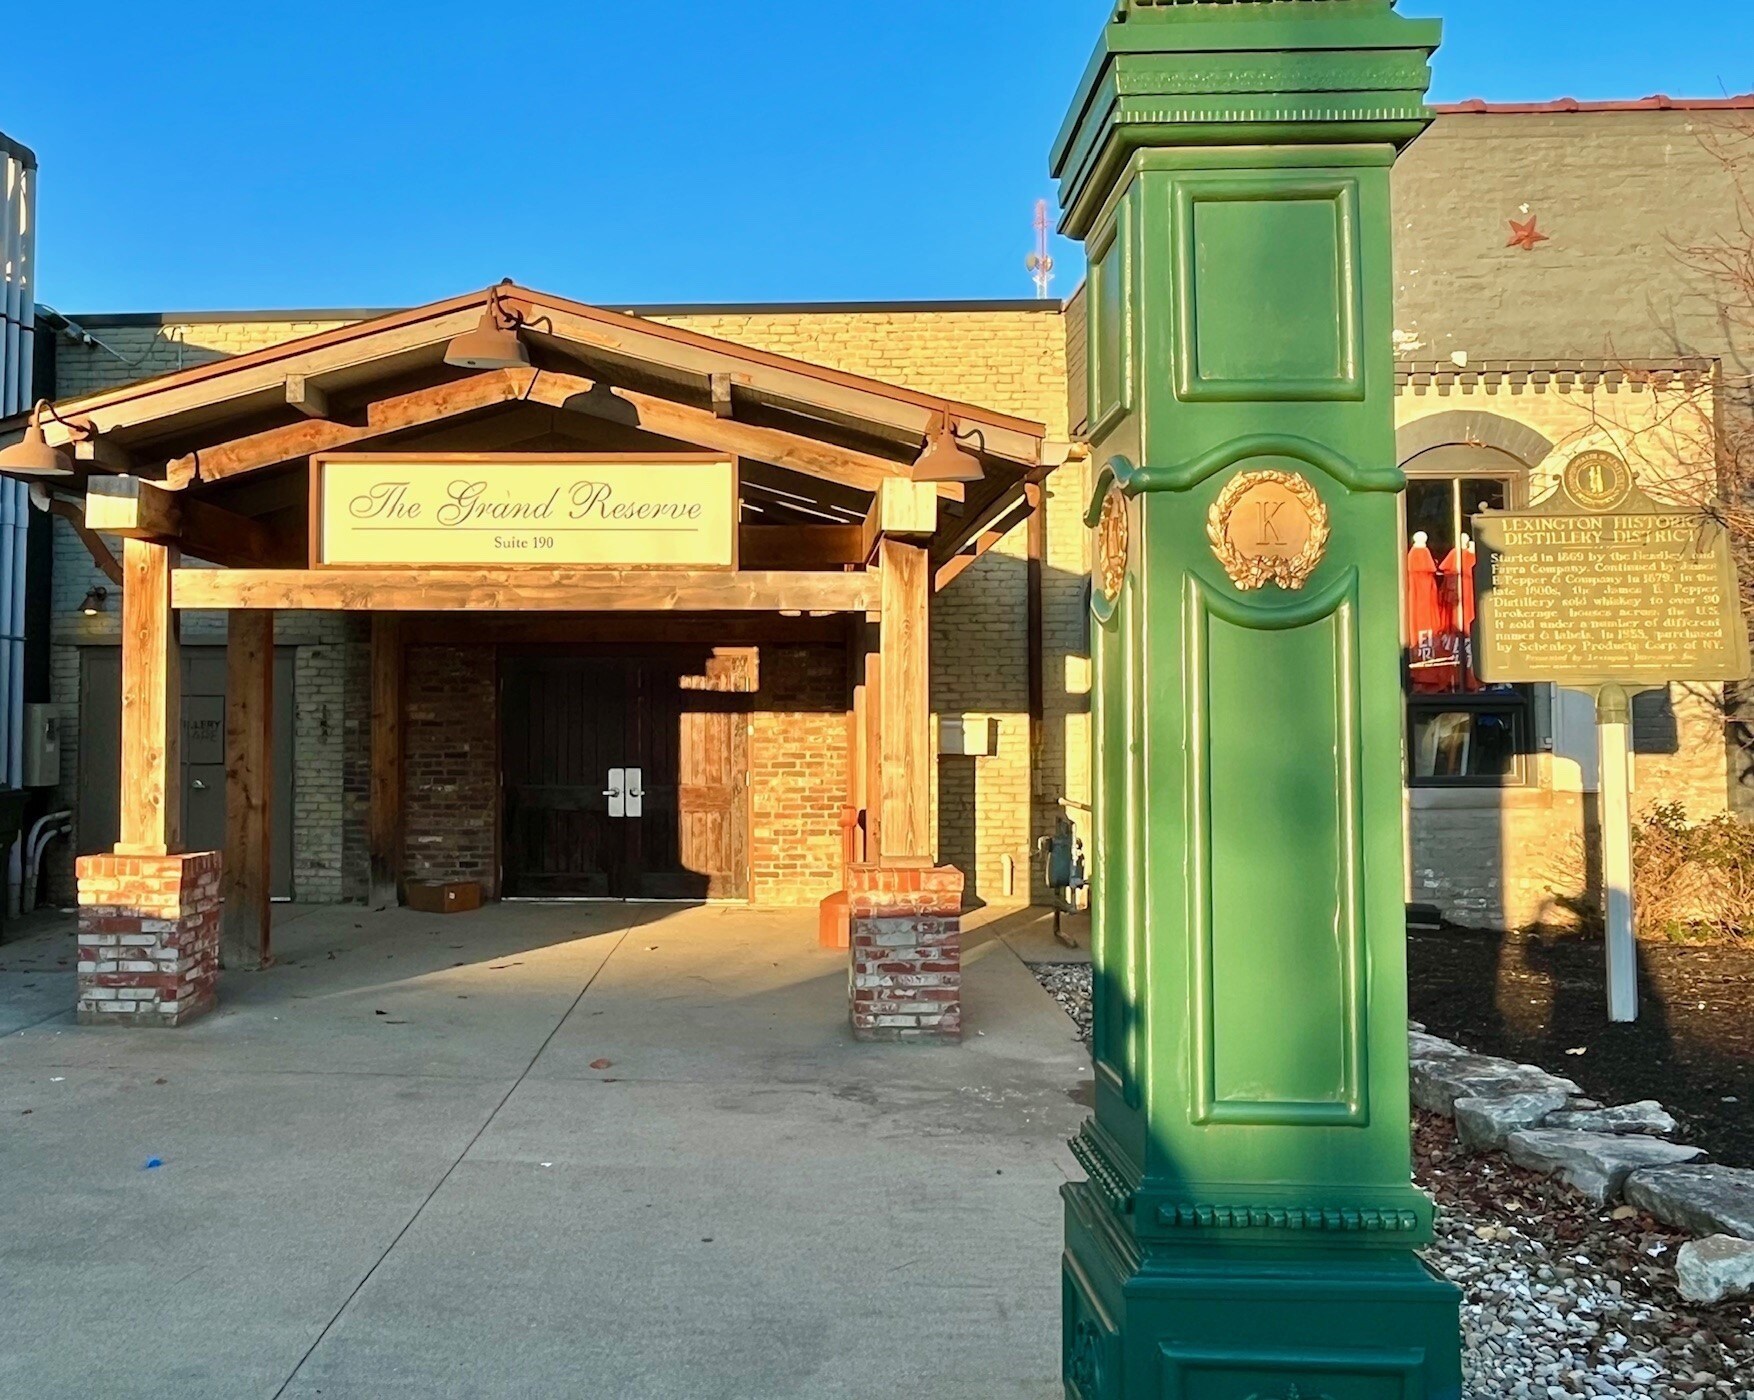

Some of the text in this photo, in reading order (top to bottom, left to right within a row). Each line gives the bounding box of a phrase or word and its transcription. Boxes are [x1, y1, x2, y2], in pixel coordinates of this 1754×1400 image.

[349, 479, 702, 526] The Grand Reserve
[1256, 501, 1287, 545] K
[1502, 516, 1699, 531] LEXINGTON HISTORIC
[494, 536, 554, 549] Suite 190
[1504, 529, 1694, 546] DISTILLERY DISTRICT
[1490, 552, 1537, 563] Started
[1557, 552, 1584, 562] 1869
[1588, 551, 1606, 563] by
[1610, 551, 1630, 561] the
[1692, 550, 1715, 560] and
[1530, 563, 1590, 575] Company.
[1594, 562, 1657, 572] Continued
[1661, 561, 1674, 573] by
[1504, 575, 1547, 587] Pepper
[1565, 575, 1622, 586] Company
[1696, 573, 1717, 582] the
[1493, 586, 1516, 596] late
[1674, 584, 1718, 596] Pepper
[1494, 597, 1555, 608] Distillery
[1562, 597, 1587, 606] sold
[1593, 597, 1641, 607] whiskey
[1649, 597, 1663, 605] to
[1669, 597, 1696, 605] over
[1494, 608, 1558, 620] brokerage
[1569, 608, 1612, 617] houses
[1509, 619, 1535, 629] sold
[1540, 619, 1574, 629] under
[1590, 618, 1640, 628] number
[1644, 618, 1659, 628] of
[1663, 617, 1720, 628] different
[1495, 633, 1535, 641] names
[1655, 628, 1722, 641] purchased
[1496, 641, 1513, 653] by
[1519, 641, 1576, 653] Schenley
[1683, 640, 1697, 650] of
